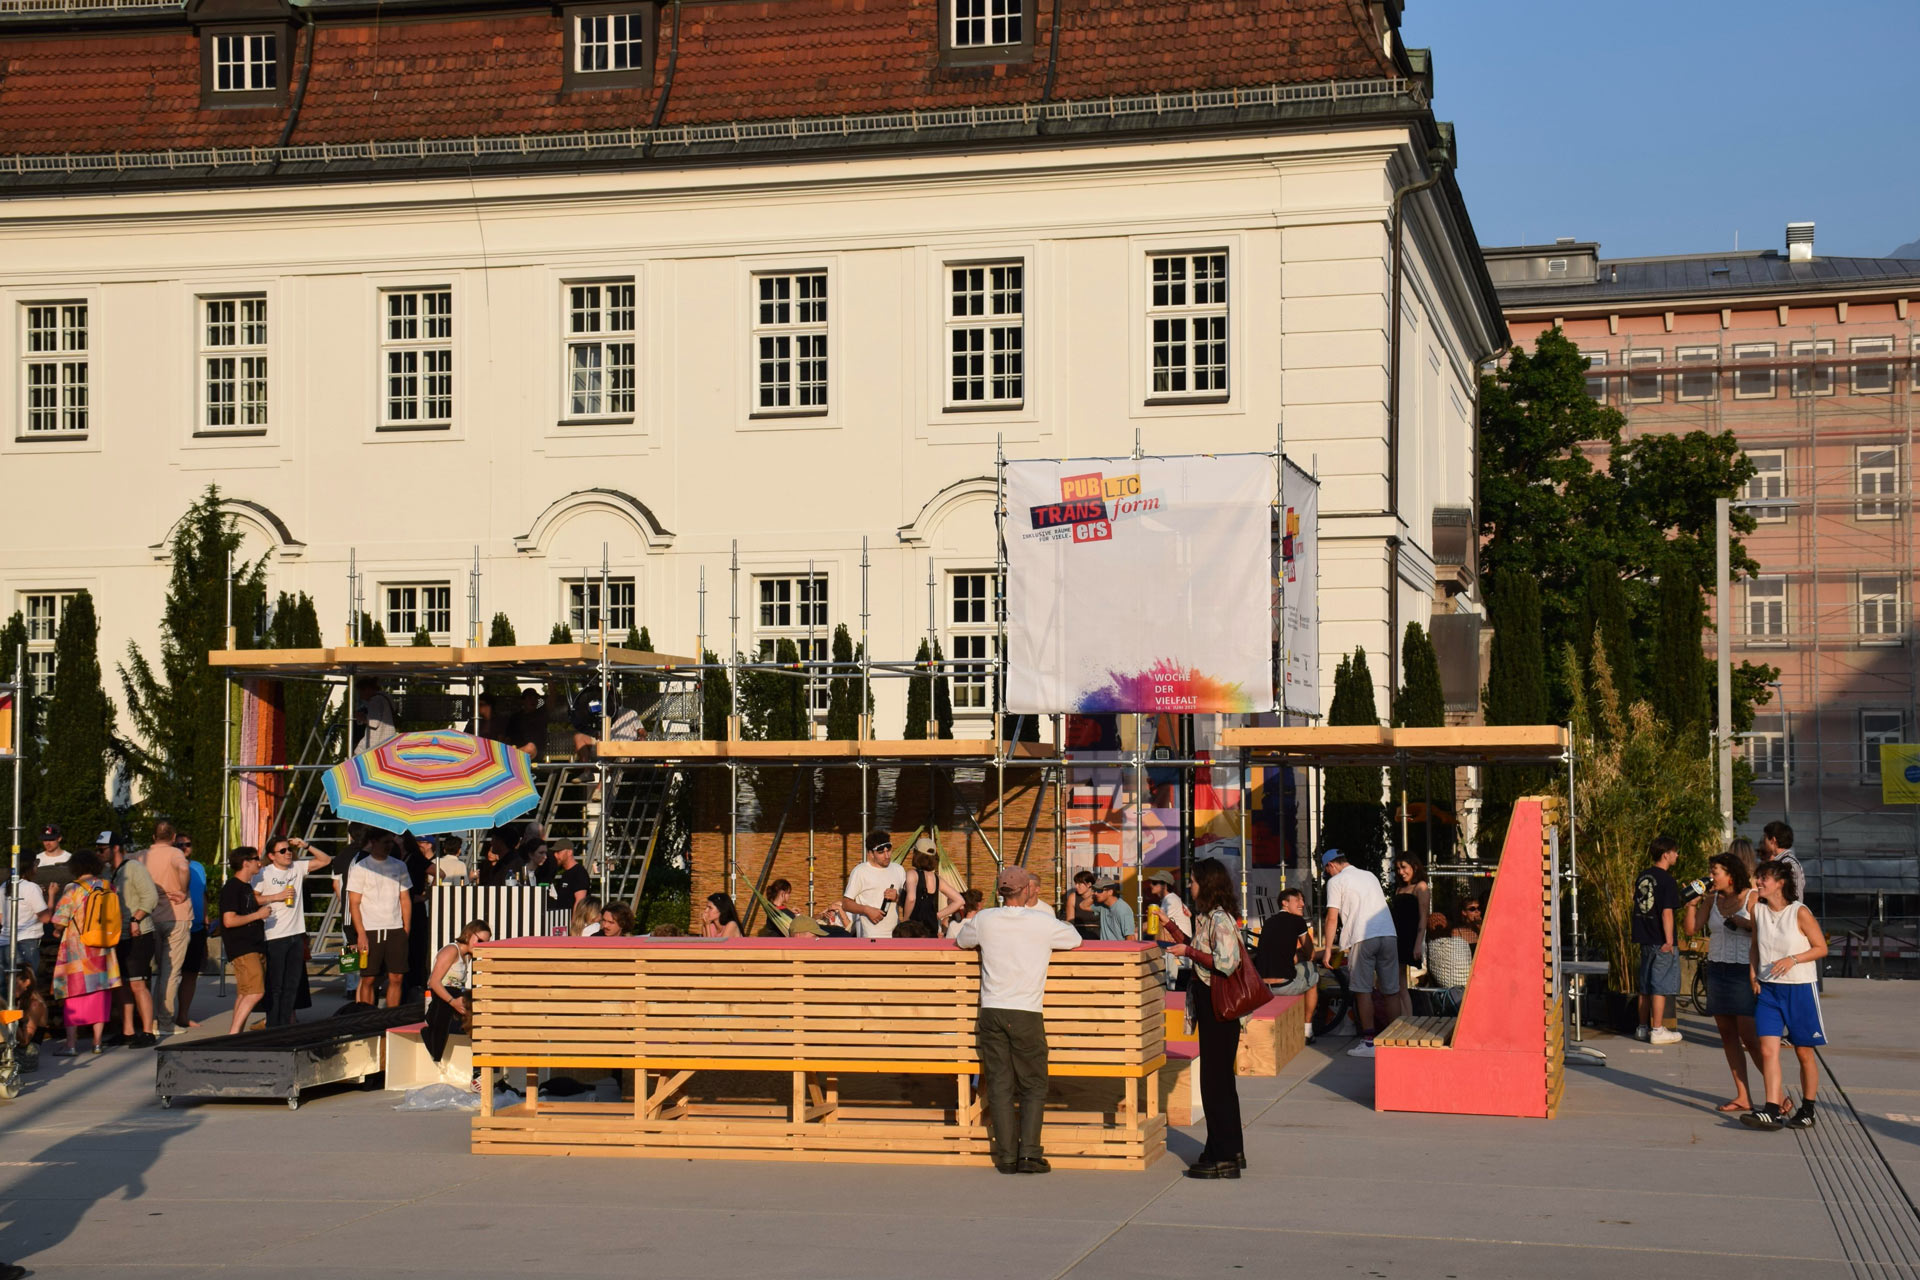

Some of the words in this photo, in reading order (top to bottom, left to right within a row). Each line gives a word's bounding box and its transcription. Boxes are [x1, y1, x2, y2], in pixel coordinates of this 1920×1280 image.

[1035, 501, 1101, 525] TRANS
[1110, 497, 1160, 521] form
[1022, 530, 1051, 539] INKLUSIVE
[1076, 521, 1107, 540] ers
[1154, 673, 1191, 681] WOCHE
[1155, 685, 1174, 693] DER
[1155, 696, 1197, 704] VIELFALT
